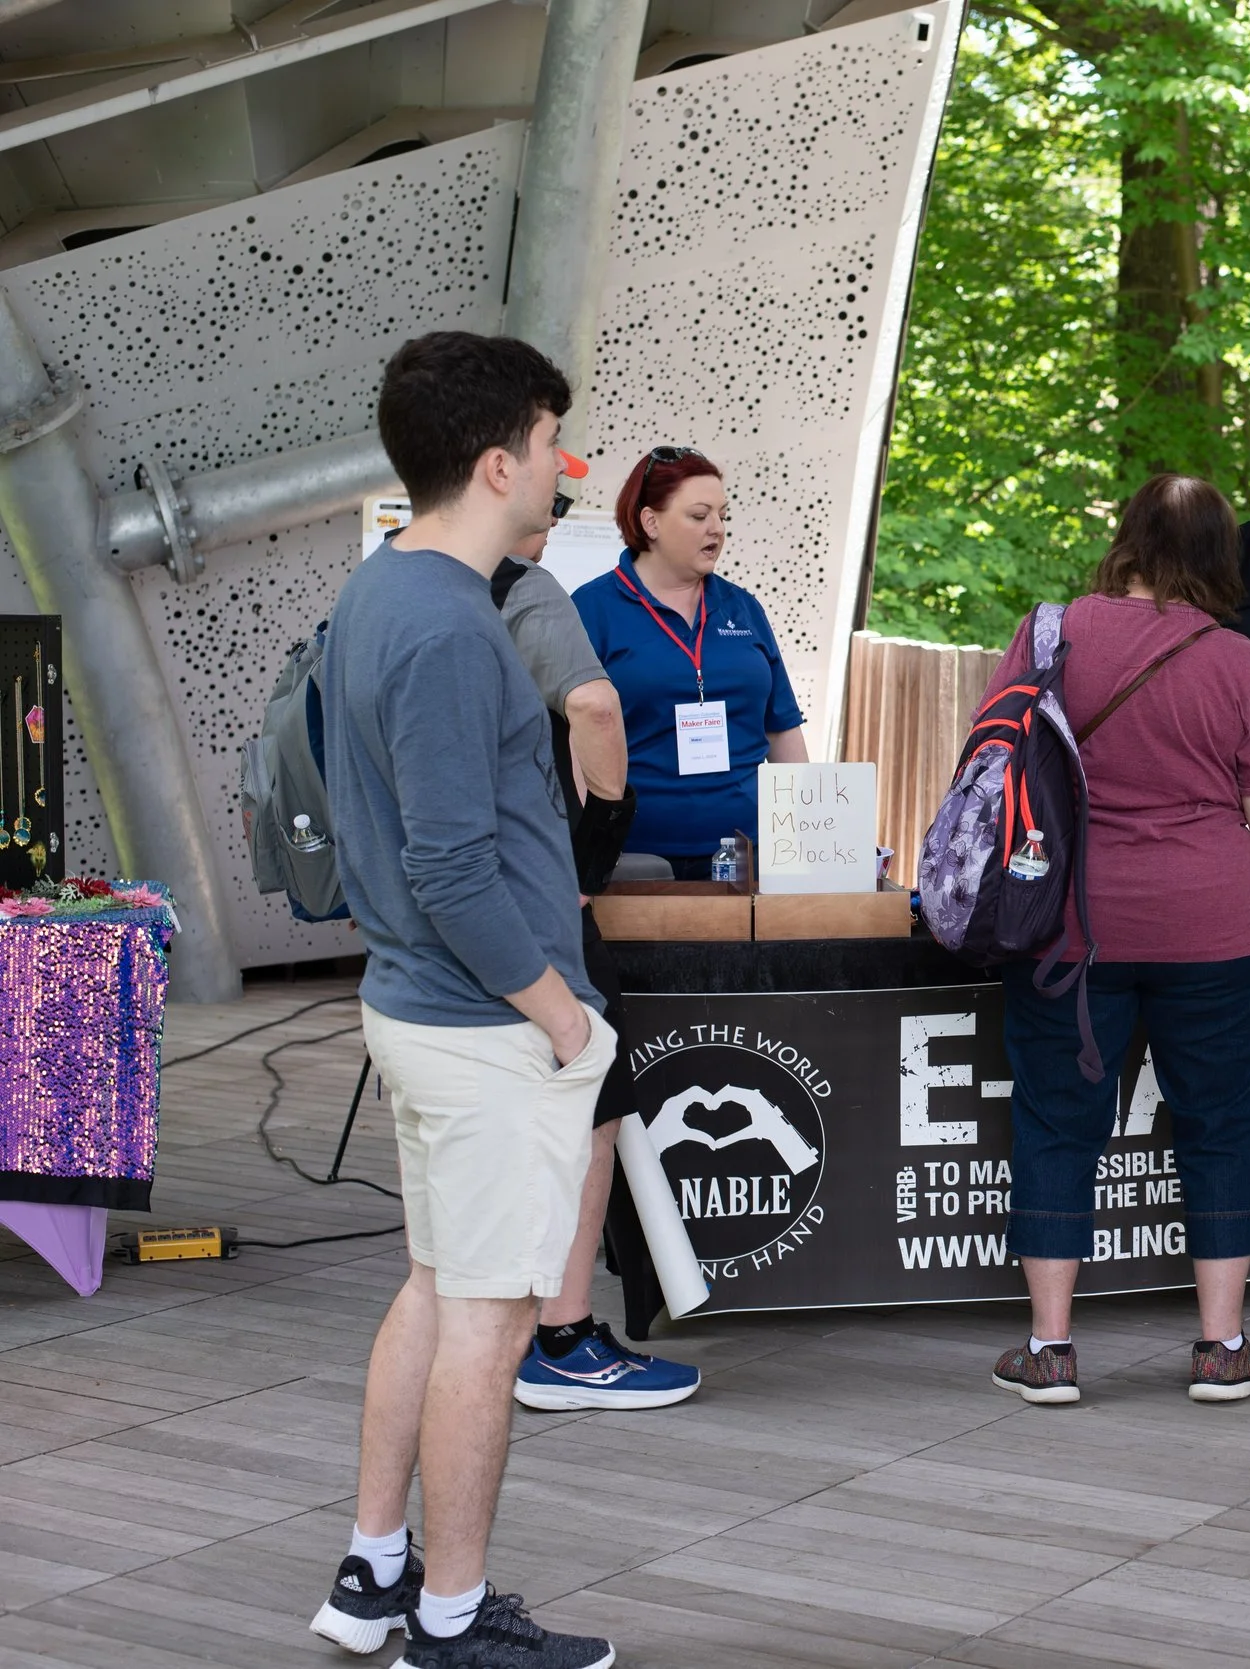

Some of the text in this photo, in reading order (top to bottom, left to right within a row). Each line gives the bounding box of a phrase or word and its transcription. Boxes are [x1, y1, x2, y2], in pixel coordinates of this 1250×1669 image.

[681, 718, 721, 728] Maker Faire
[773, 772, 849, 805] Hulk
[772, 812, 836, 833] Move
[771, 838, 858, 866] Blocks
[690, 1024, 746, 1045] THE
[757, 1032, 832, 1098] WORLD
[924, 1161, 960, 1187] TO
[970, 1159, 1013, 1185] MA
[1096, 1150, 1177, 1180] SSIBLE
[676, 1174, 791, 1220] NABLE
[896, 1166, 917, 1223] VERB:
[924, 1191, 960, 1217] TO
[1094, 1182, 1138, 1210] THE
[1145, 1178, 1185, 1206] ME
[751, 1205, 825, 1271] HAND
[340, 1578, 363, 1592] adidas
